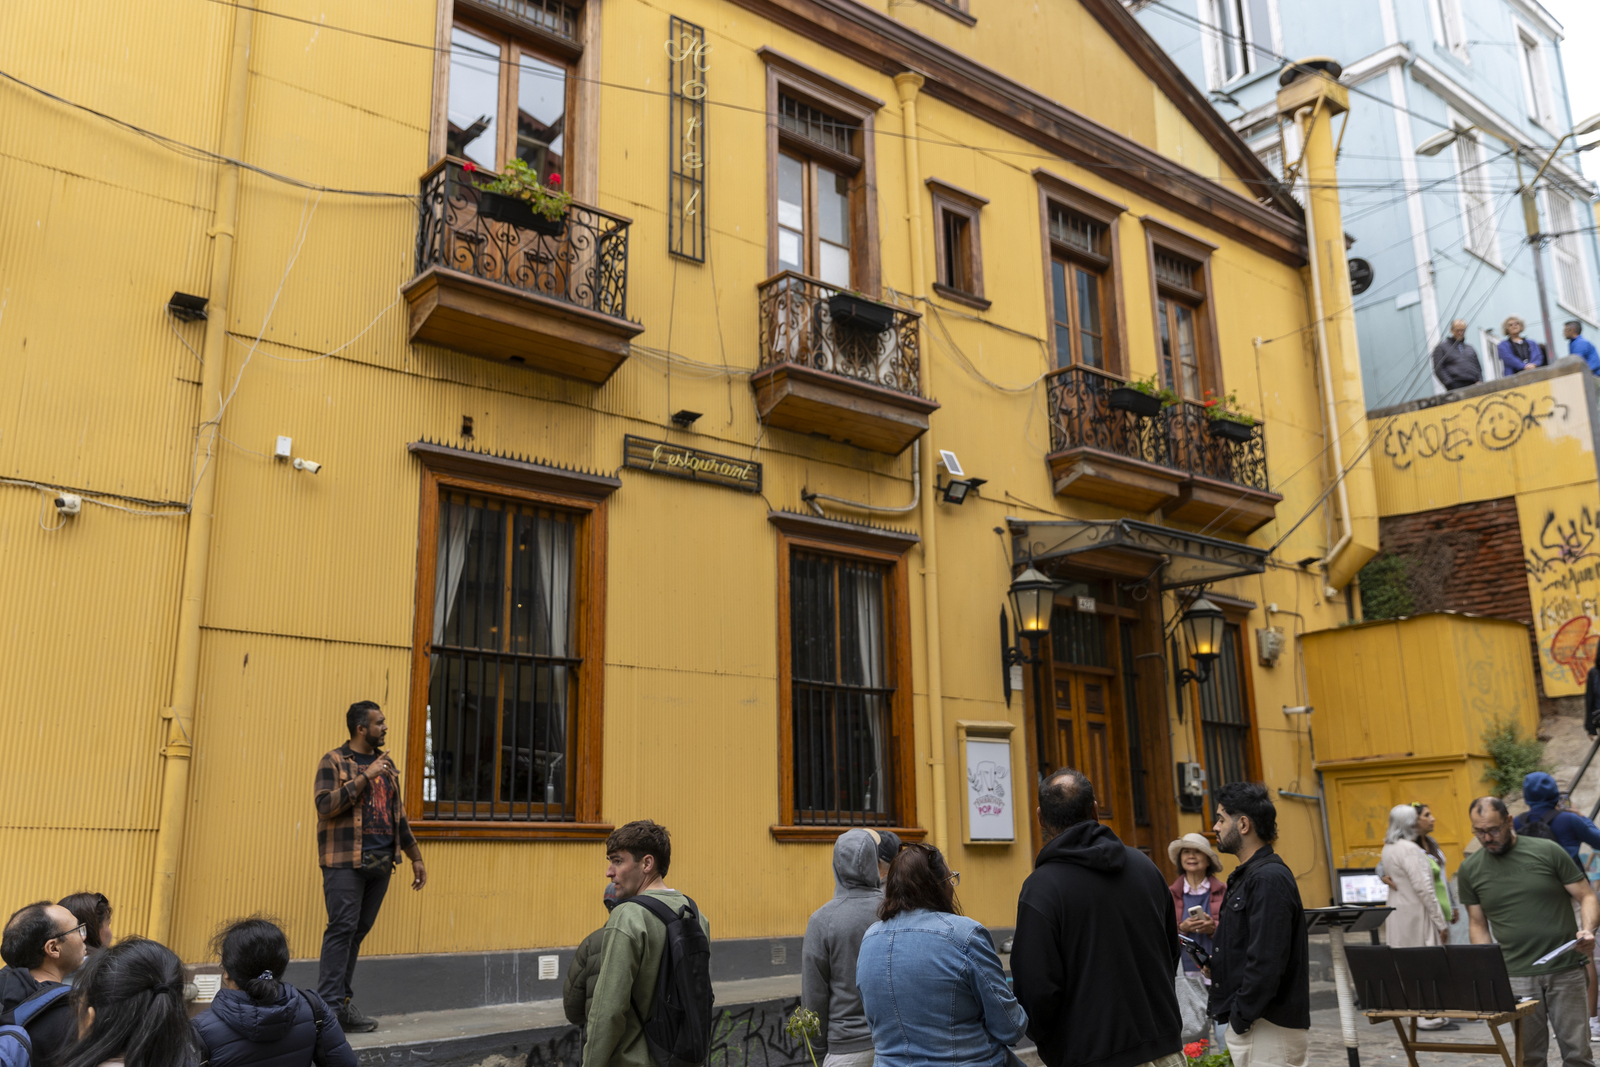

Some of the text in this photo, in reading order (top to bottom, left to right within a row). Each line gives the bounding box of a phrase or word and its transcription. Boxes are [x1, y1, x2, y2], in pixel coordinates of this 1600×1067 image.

[664, 32, 714, 216] Hotel
[978, 804, 1002, 815] POP UP
